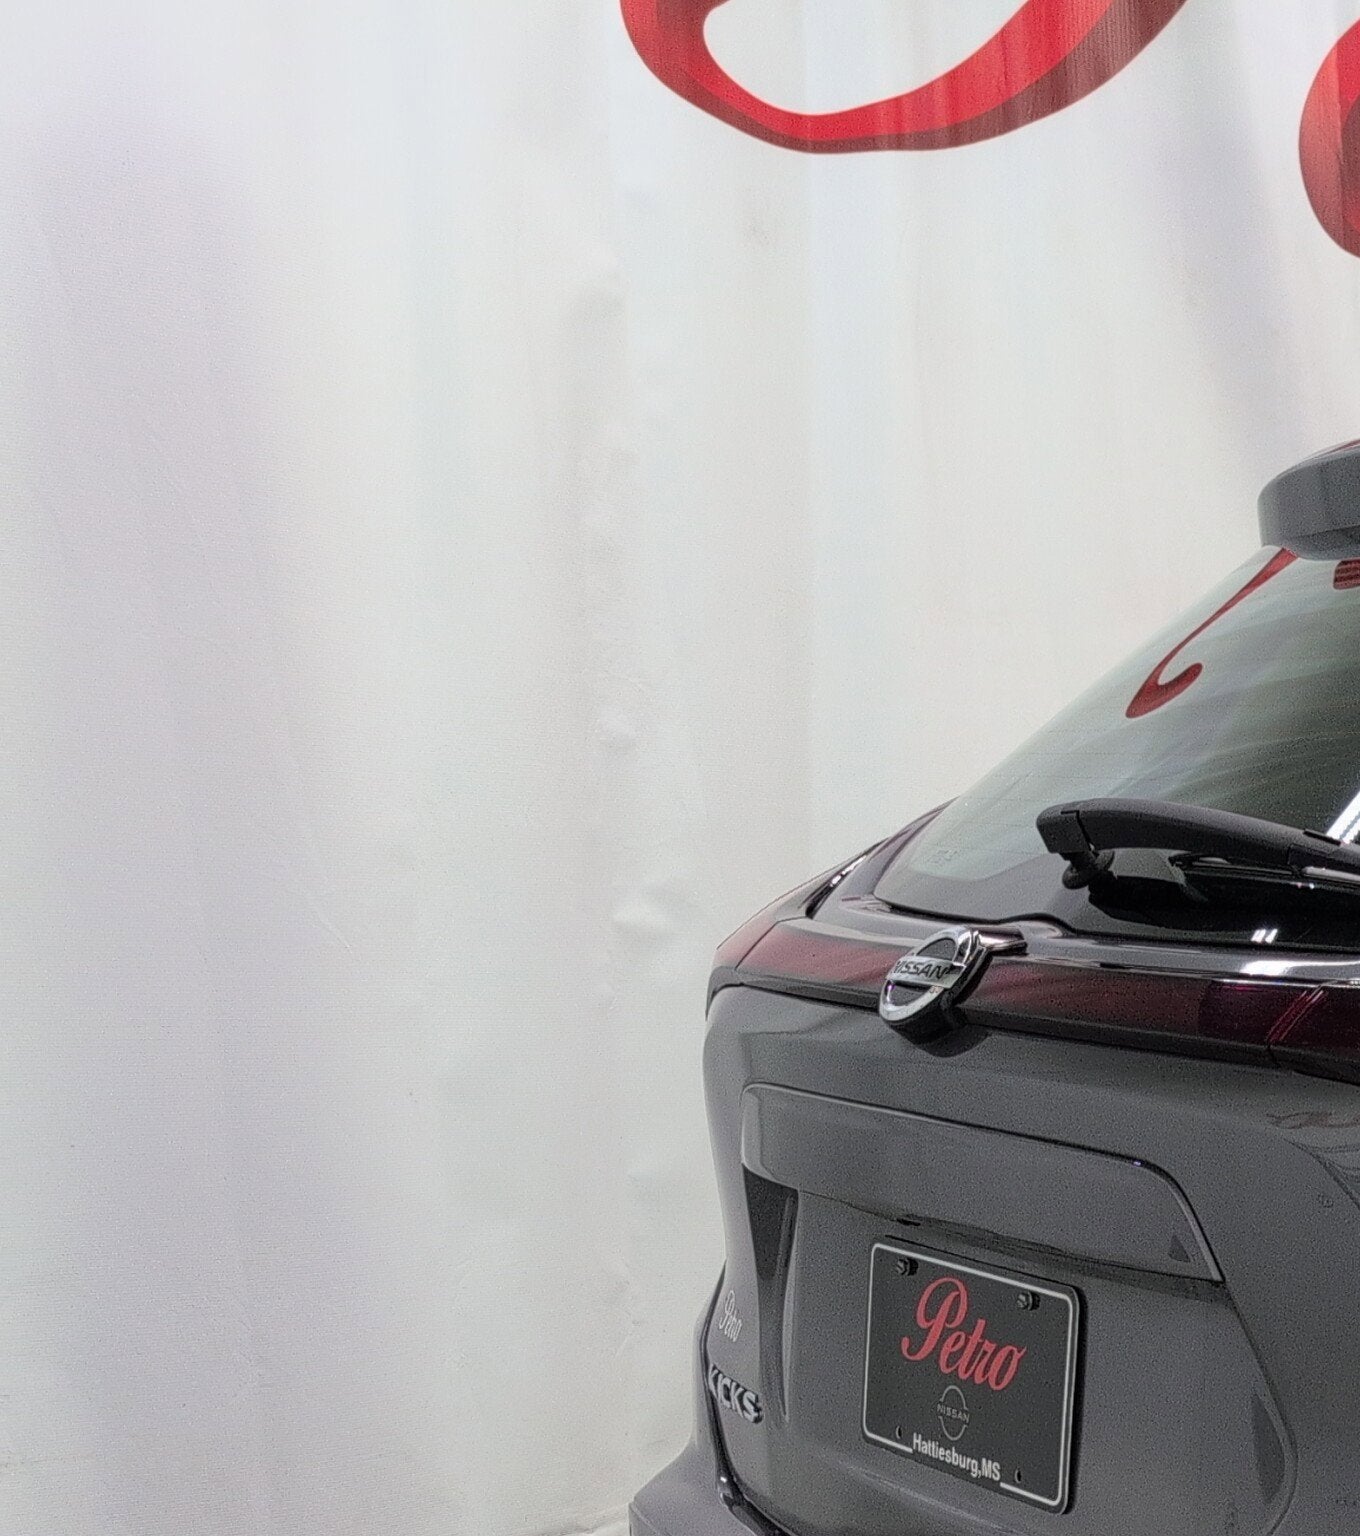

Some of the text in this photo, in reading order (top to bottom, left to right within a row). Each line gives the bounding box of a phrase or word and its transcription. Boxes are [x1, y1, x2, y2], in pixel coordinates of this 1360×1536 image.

[901, 1276, 1027, 1391] Petro
[708, 1364, 763, 1424] KICKS
[937, 1402, 970, 1424] NISSAN
